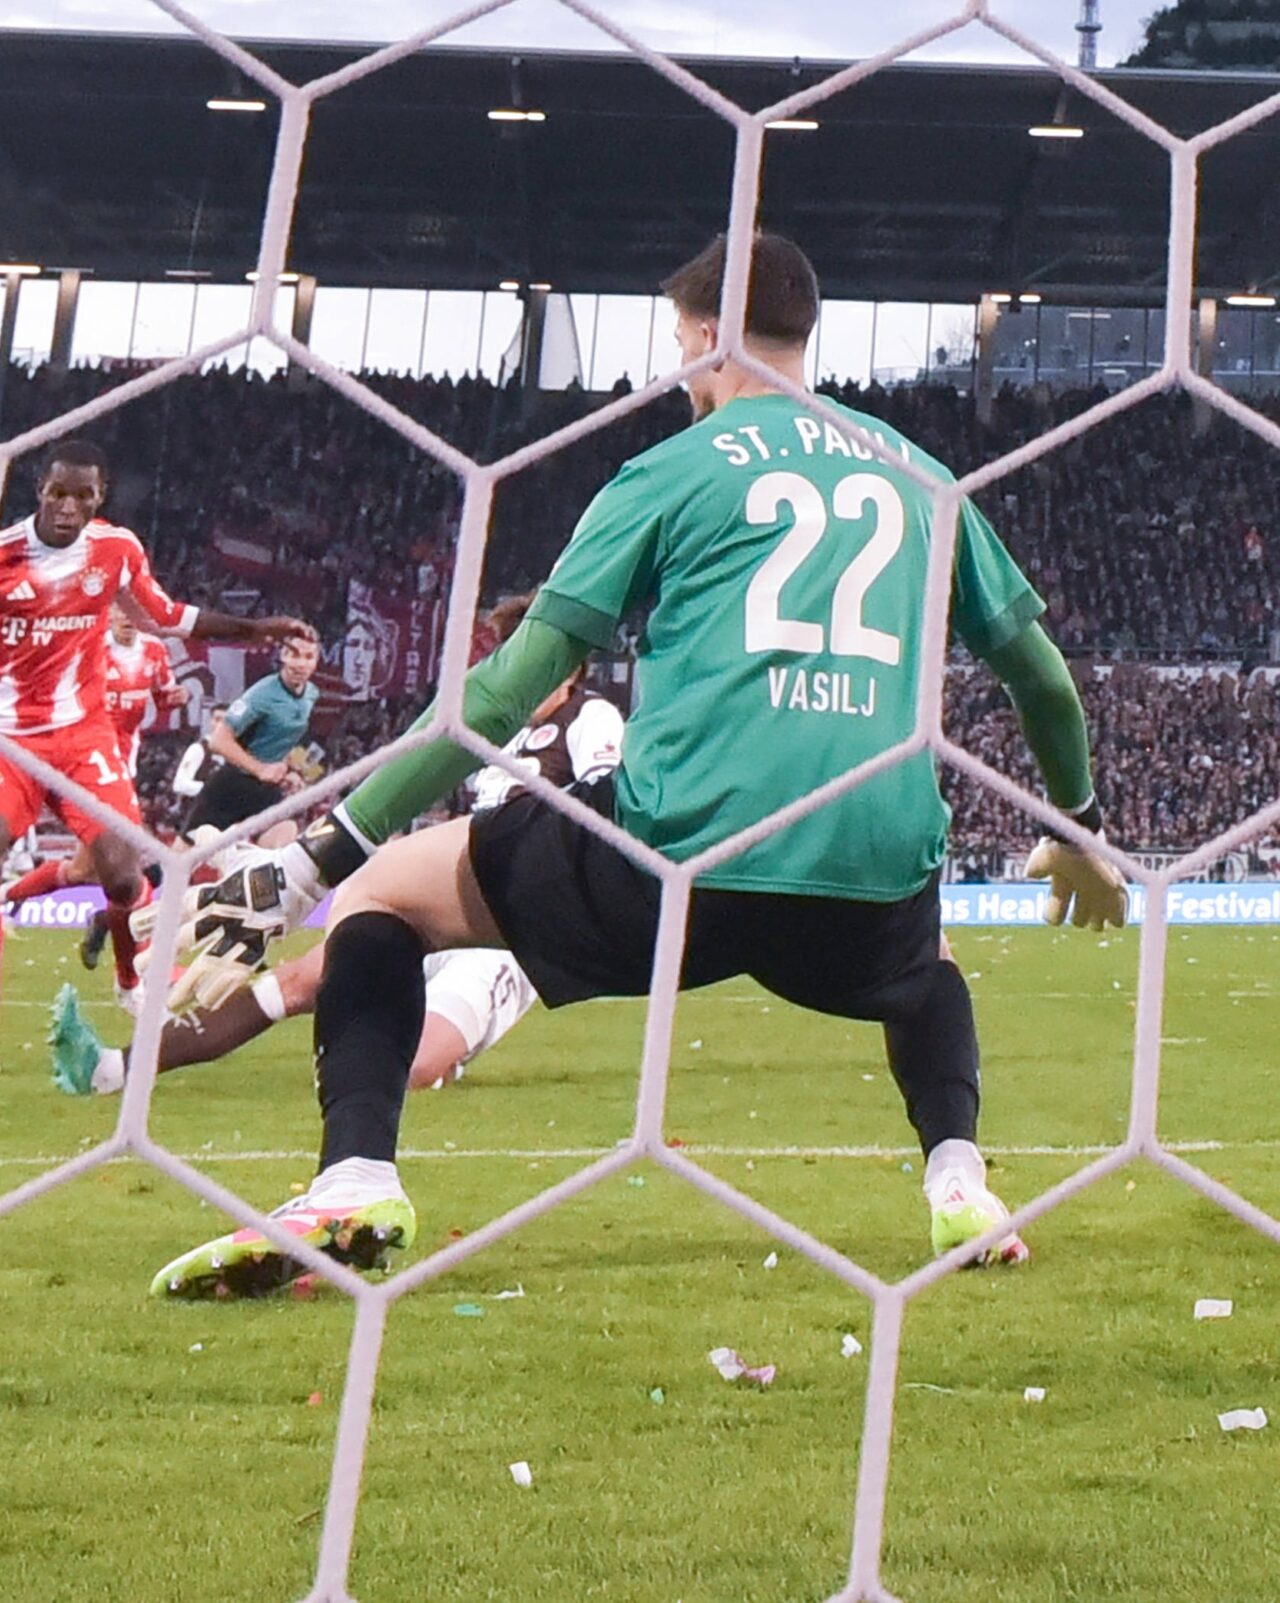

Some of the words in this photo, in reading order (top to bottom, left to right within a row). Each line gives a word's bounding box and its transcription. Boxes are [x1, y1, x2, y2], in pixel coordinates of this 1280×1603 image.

[712, 425, 790, 466] ST.
[744, 471, 905, 667] 22
[32, 631, 54, 647] TV
[768, 666, 876, 717] VASILJ
[978, 891, 1044, 920] Heal
[1166, 890, 1280, 919] Festival
